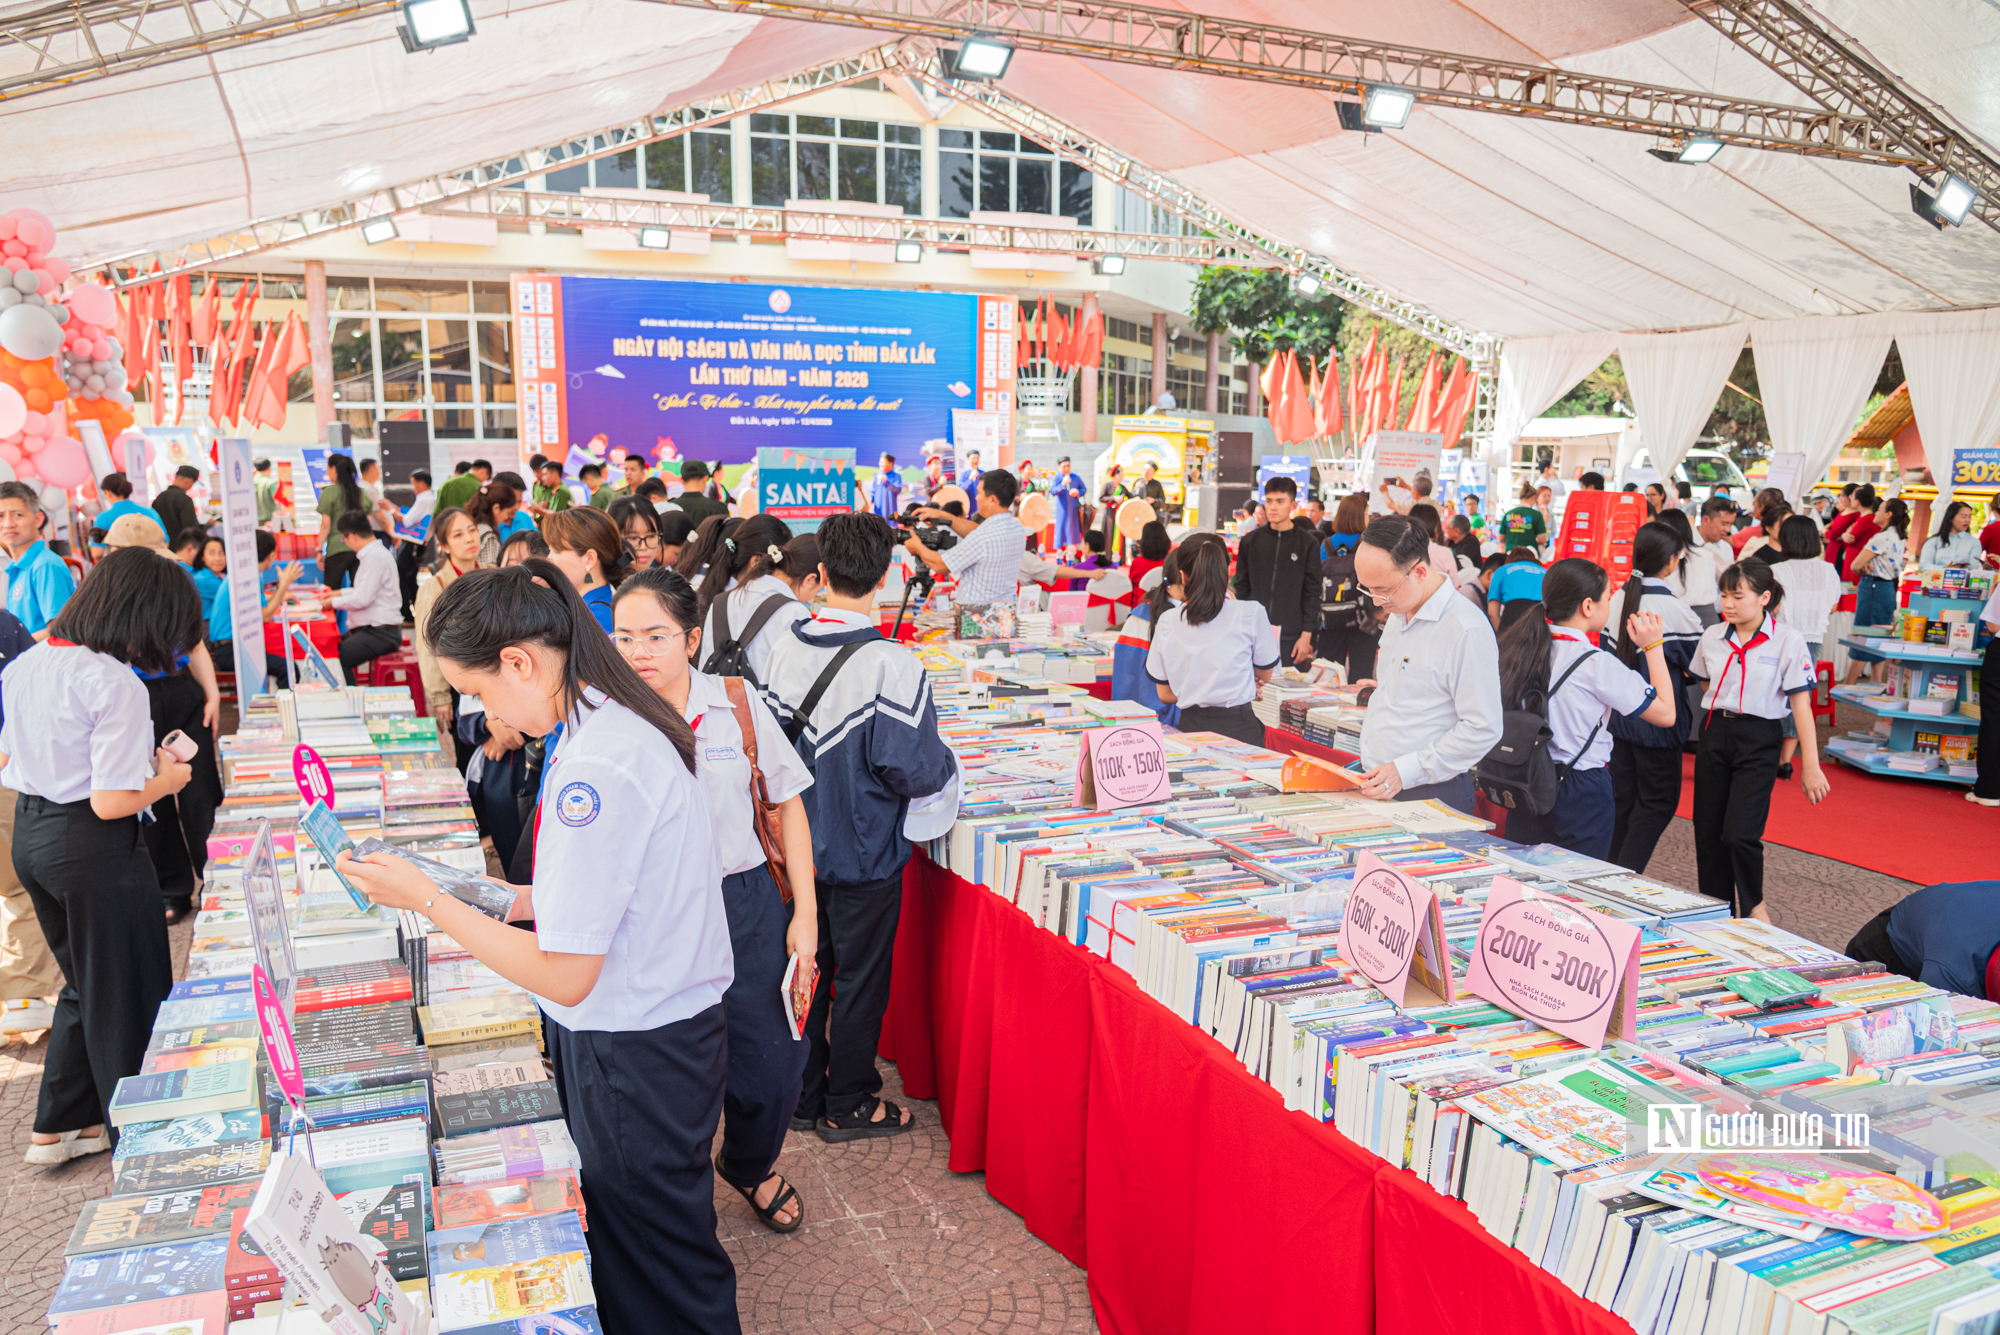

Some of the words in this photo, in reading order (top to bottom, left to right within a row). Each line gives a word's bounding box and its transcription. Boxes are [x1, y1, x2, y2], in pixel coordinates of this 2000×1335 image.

[613, 335, 655, 357] NGÀY
[657, 336, 684, 361] HỘI
[686, 337, 727, 359] SÁCH
[728, 338, 749, 360] VÀ
[751, 339, 781, 360] VĂN
[783, 340, 813, 361] HÓA
[814, 344, 844, 365] ĐỌC
[845, 340, 878, 363] TỈNH
[880, 341, 908, 363] ĐẮK
[910, 342, 936, 364] LẮK
[690, 361, 720, 385] LẦN
[722, 365, 752, 386] THỨ
[753, 366, 787, 386] NĂM
[799, 367, 832, 387] NĂM
[834, 371, 869, 388] 2026
[1984, 451, 1998, 459] GIÁ
[766, 482, 841, 505] SANTA
[770, 508, 788, 517] SÁCH
[789, 508, 816, 517] TRUYỆN
[1098, 755, 1126, 780] 110K
[1133, 750, 1162, 775] 150K
[1372, 878, 1382, 891] SÁCH
[1382, 886, 1397, 901] ĐỒNG
[1395, 896, 1405, 906] GIÁ
[1350, 895, 1376, 935] 160K
[1378, 915, 1410, 960] 200K
[1522, 911, 1546, 927] SÁCH
[1547, 920, 1573, 937] ĐỒNG
[1574, 932, 1590, 945] GIÁ
[1489, 924, 1542, 970] 200K
[1550, 950, 1609, 999] 300K
[1282, 981, 1316, 990] DOTCOM
[1508, 978, 1522, 988] NHÀ
[1523, 983, 1540, 996] SÁCH
[1540, 991, 1566, 1008] FAHASA
[1511, 984, 1528, 996] BUÔN
[1528, 993, 1538, 1002] MA
[1539, 997, 1561, 1012] THUỘT
[217, 1144, 242, 1177] HOLMES
[238, 1140, 264, 1176] SHERLOCK
[142, 1192, 176, 1214] Puzo
[168, 1189, 202, 1214] Mario
[517, 1233, 530, 1248] HÓA
[529, 1219, 544, 1241] KHÔNG
[1939, 1226, 1988, 1242] BRAZIL
[503, 1239, 515, 1251] HƠI
[506, 1251, 517, 1262] KHI
[263, 1242, 272, 1252] Tớ
[270, 1250, 278, 1259] là
[276, 1258, 289, 1273] mèo
[287, 1270, 311, 1299] Pusheen
[273, 1234, 282, 1245] Tớ
[280, 1243, 288, 1252] là
[285, 1251, 299, 1266] mèo
[297, 1262, 321, 1292] Pusheen
